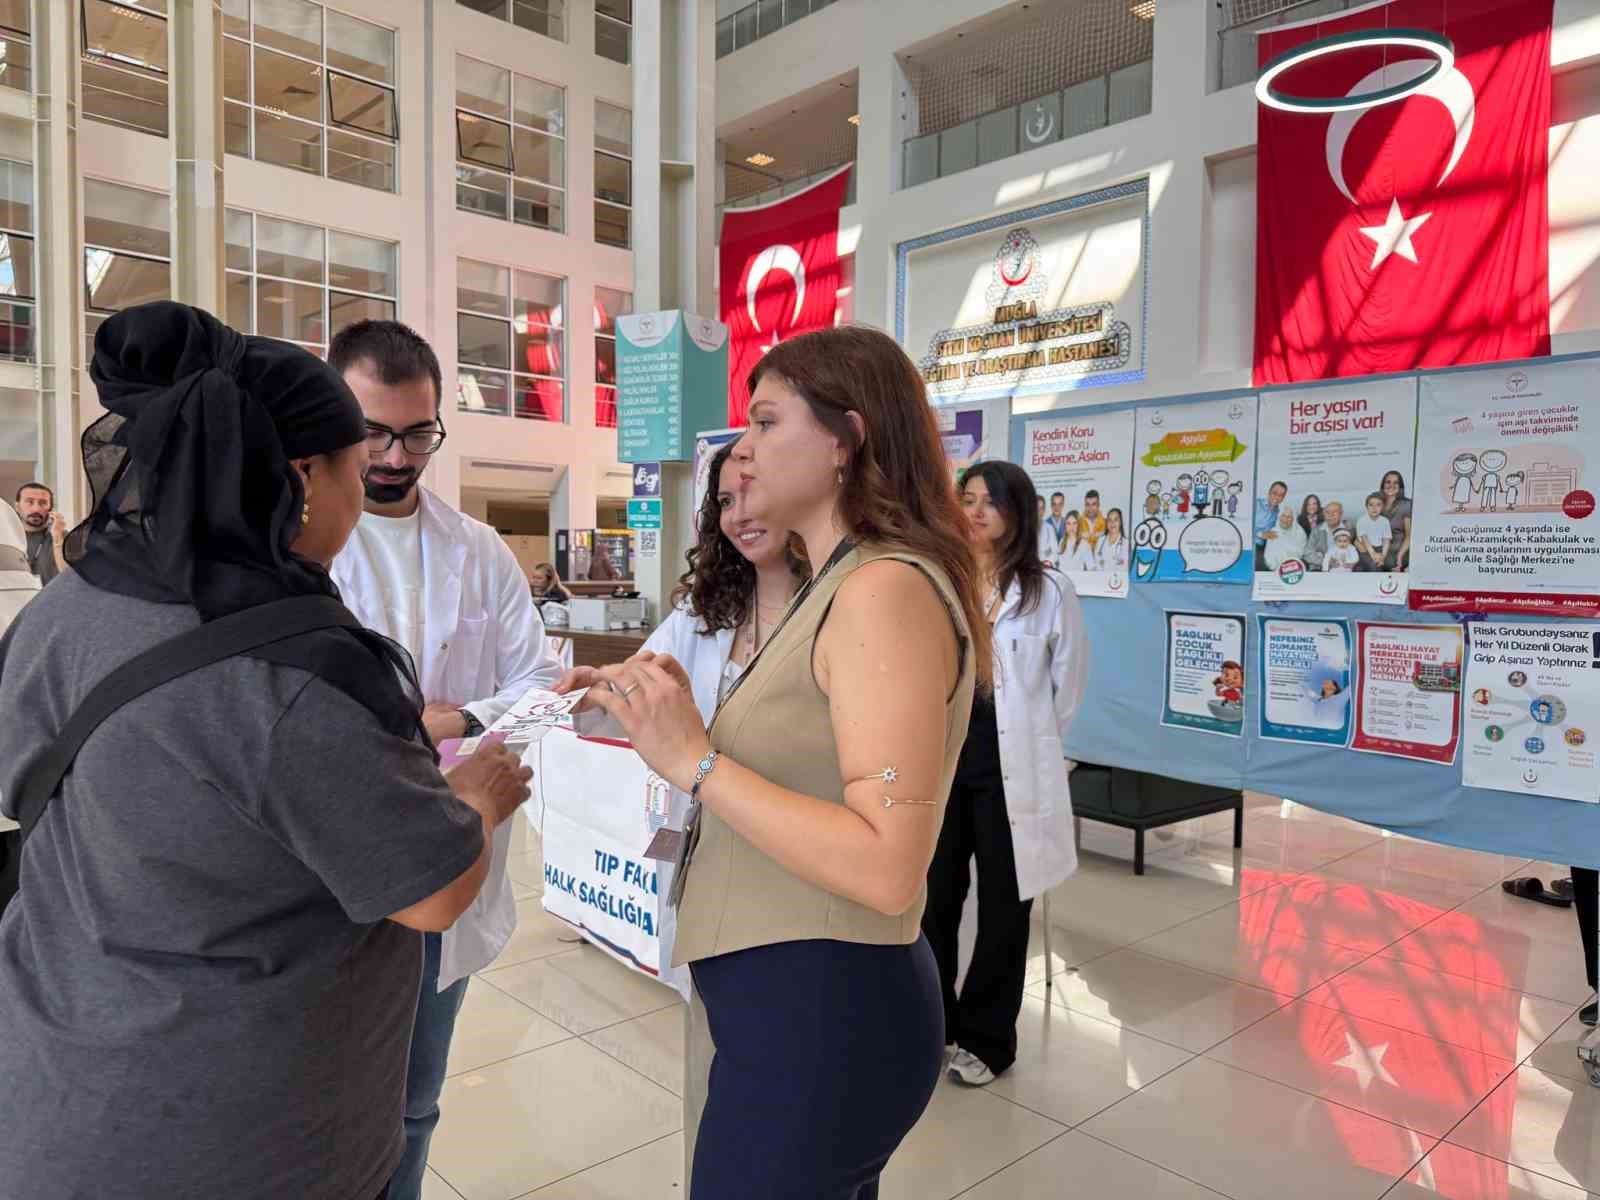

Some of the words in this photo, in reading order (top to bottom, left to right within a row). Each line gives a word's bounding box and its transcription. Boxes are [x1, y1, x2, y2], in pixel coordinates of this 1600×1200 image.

[994, 301, 1037, 323] MUĞLA
[966, 329, 1014, 353] KOÇMAN
[1018, 310, 1102, 344] ÜNİVERSİTESİ
[980, 350, 1046, 376] ARAŞTIRMA
[1048, 333, 1120, 364] HASTANESİ
[1291, 401, 1320, 418] Her
[1322, 399, 1367, 420] yaşın
[1541, 403, 1579, 416] çocuklar
[1290, 418, 1311, 435] bir
[1313, 417, 1348, 436] aşısı
[1352, 410, 1384, 430] var!
[1529, 413, 1579, 425] takviminde
[1032, 427, 1068, 441] Kendini
[1071, 425, 1095, 438] Koru
[1450, 525, 1502, 535] Çocuğunuz
[1514, 525, 1553, 536] yaşında
[1555, 525, 1570, 533] ise
[1453, 545, 1484, 553] Karma
[1534, 546, 1600, 557] uygulanması
[1463, 554, 1482, 563] Aile
[1521, 555, 1575, 564] Merkezi'ne
[1478, 564, 1537, 576] başvurunuz.
[1473, 626, 1496, 636] Risk
[1498, 627, 1589, 640] Grubundaysanız
[1474, 639, 1493, 650] Her
[1496, 640, 1509, 650] Yıl
[1511, 640, 1551, 652] Düzenli
[1552, 643, 1589, 654] Olarak
[1473, 652, 1496, 665] Grip
[594, 848, 620, 877] TIP
[544, 861, 577, 898] HALK
